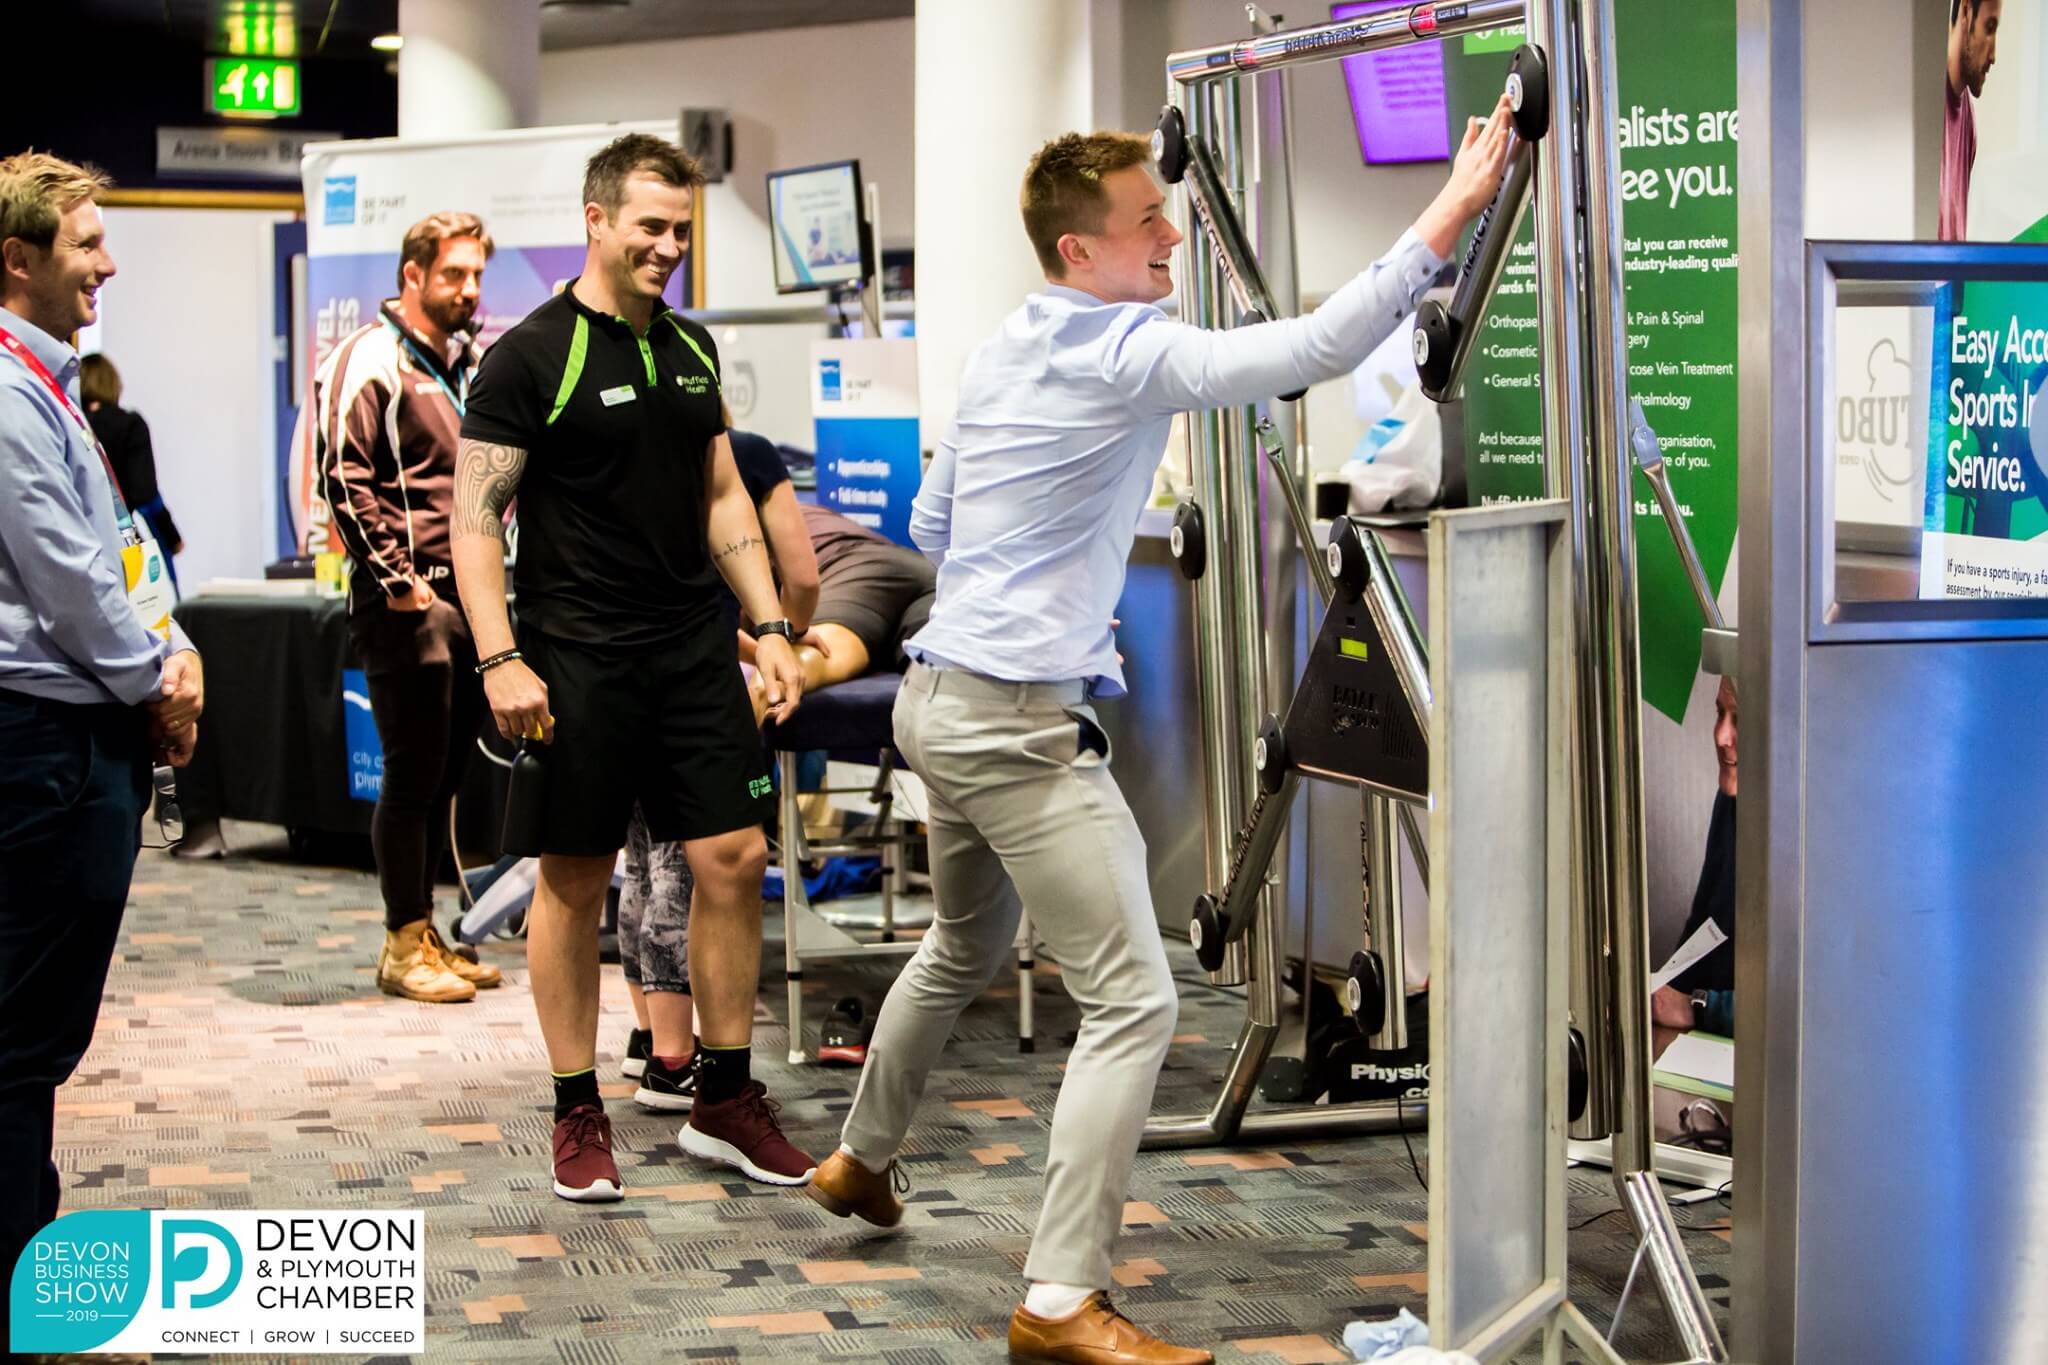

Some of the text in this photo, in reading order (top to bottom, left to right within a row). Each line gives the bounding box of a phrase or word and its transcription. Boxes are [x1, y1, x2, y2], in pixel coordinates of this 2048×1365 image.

[1664, 165, 1733, 209] you.
[1643, 240, 1664, 255] you
[1667, 239, 1686, 250] can
[1688, 234, 1728, 249] receive
[1637, 313, 1658, 325] Pain
[1662, 312, 1669, 324] &
[1672, 311, 1704, 328] Spinal
[1491, 345, 1538, 358] Cosmetic
[1951, 316, 1999, 378] Easy
[1656, 362, 1678, 375] Vein
[1681, 362, 1734, 375] Treatment
[1491, 373, 1531, 387] General
[1949, 377, 2017, 438] Sports
[1479, 432, 1542, 445] And because
[1480, 450, 1490, 463] all
[1491, 453, 1506, 464] we
[1508, 450, 1535, 464] need
[1675, 452, 1686, 466] of
[1688, 456, 1711, 471] you.
[1946, 439, 2026, 493] Service.
[422, 565, 449, 581] JP
[1947, 558, 1953, 573] If
[1954, 563, 1965, 577] you
[1966, 561, 1981, 576] have
[1983, 567, 1988, 576] a
[1989, 567, 2010, 582] sports
[2012, 567, 2032, 587] injury,
[2034, 573, 2039, 584] a
